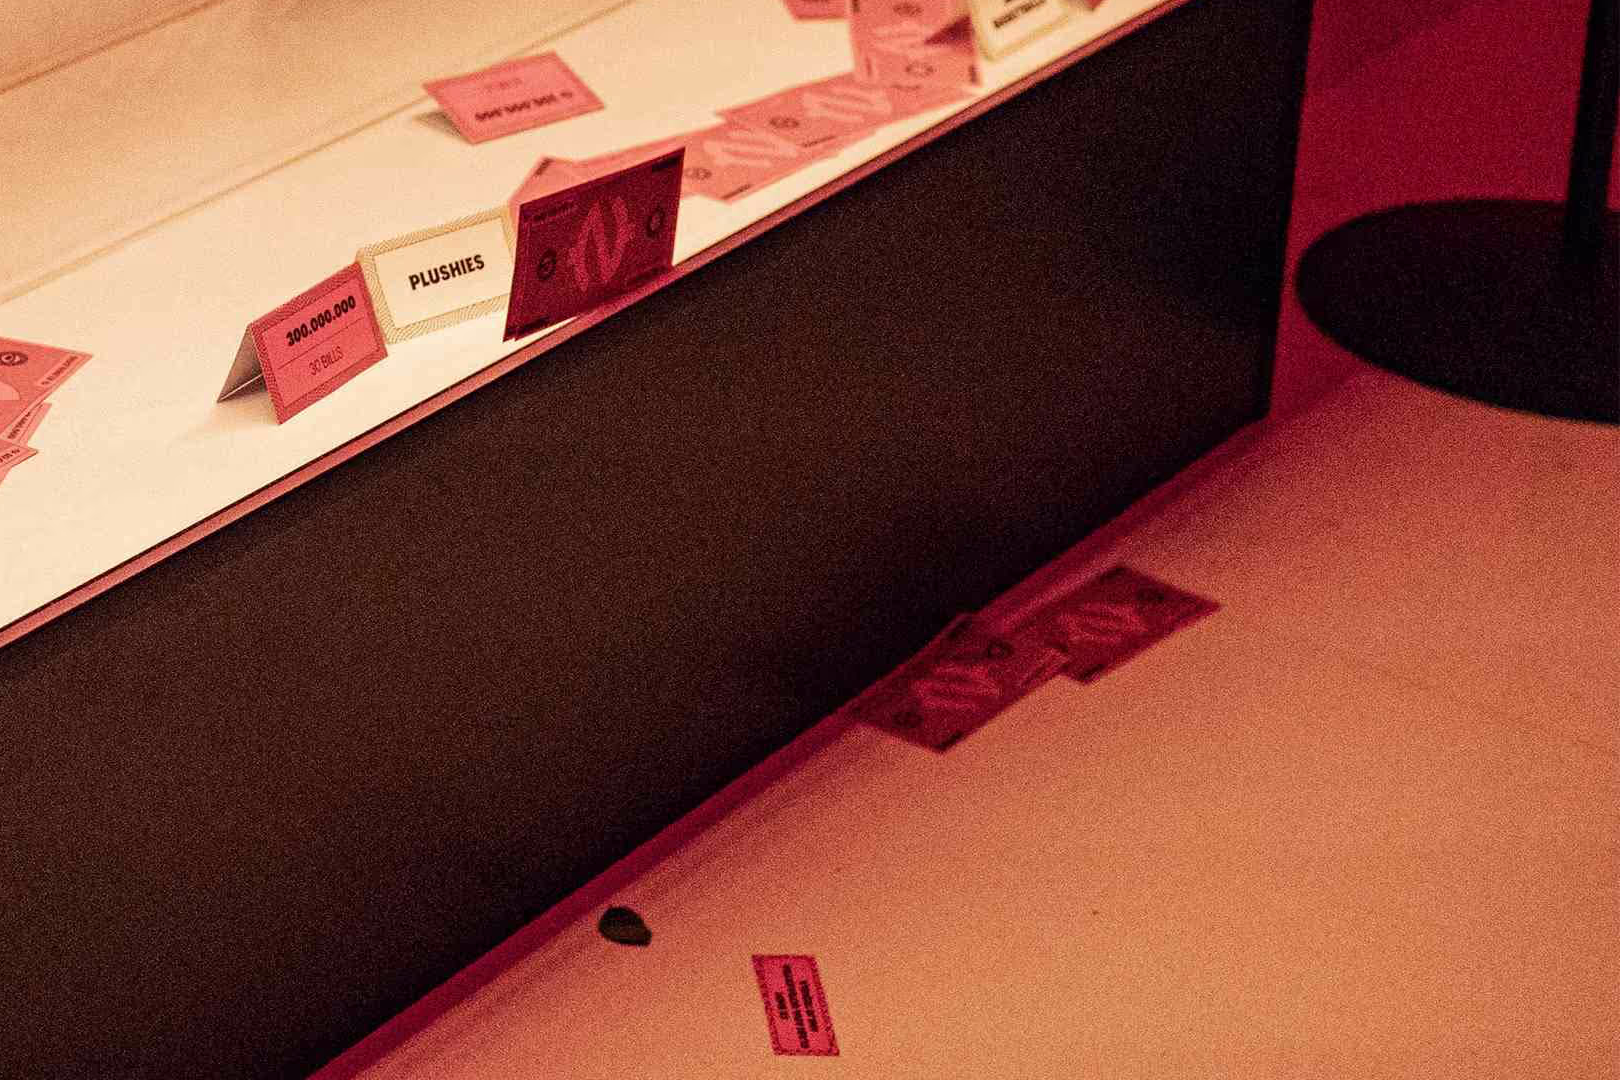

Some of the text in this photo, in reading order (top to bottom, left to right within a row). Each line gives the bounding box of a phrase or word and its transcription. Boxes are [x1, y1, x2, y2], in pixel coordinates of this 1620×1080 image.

[408, 253, 485, 291] PLUSHIES
[286, 295, 357, 347] 300.000.000
[308, 345, 344, 376] 30 BILLS
